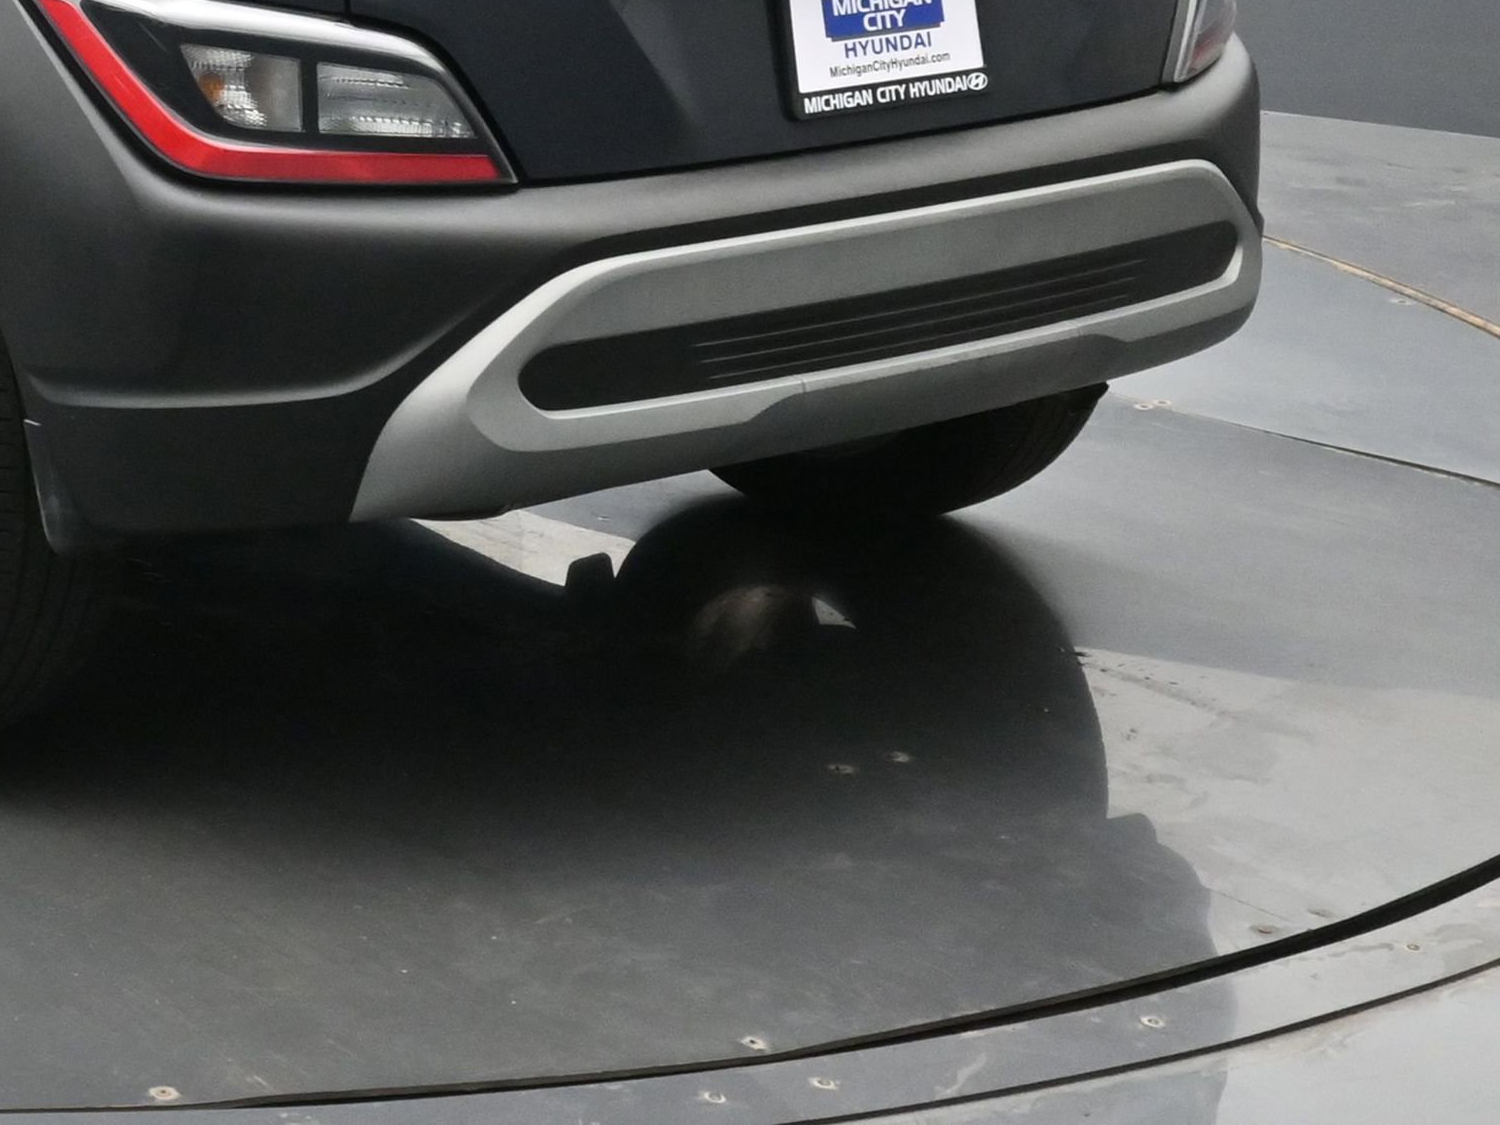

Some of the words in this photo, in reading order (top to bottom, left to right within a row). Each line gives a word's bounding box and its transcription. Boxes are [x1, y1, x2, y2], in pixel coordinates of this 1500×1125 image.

[863, 9, 906, 32] CITY
[844, 31, 932, 59] HYUNDAI
[829, 51, 951, 78] MichiganCityHyundai.com
[803, 89, 873, 114] MICHIGAN
[876, 82, 906, 103] CITY
[909, 75, 968, 98] HYUNDAI
